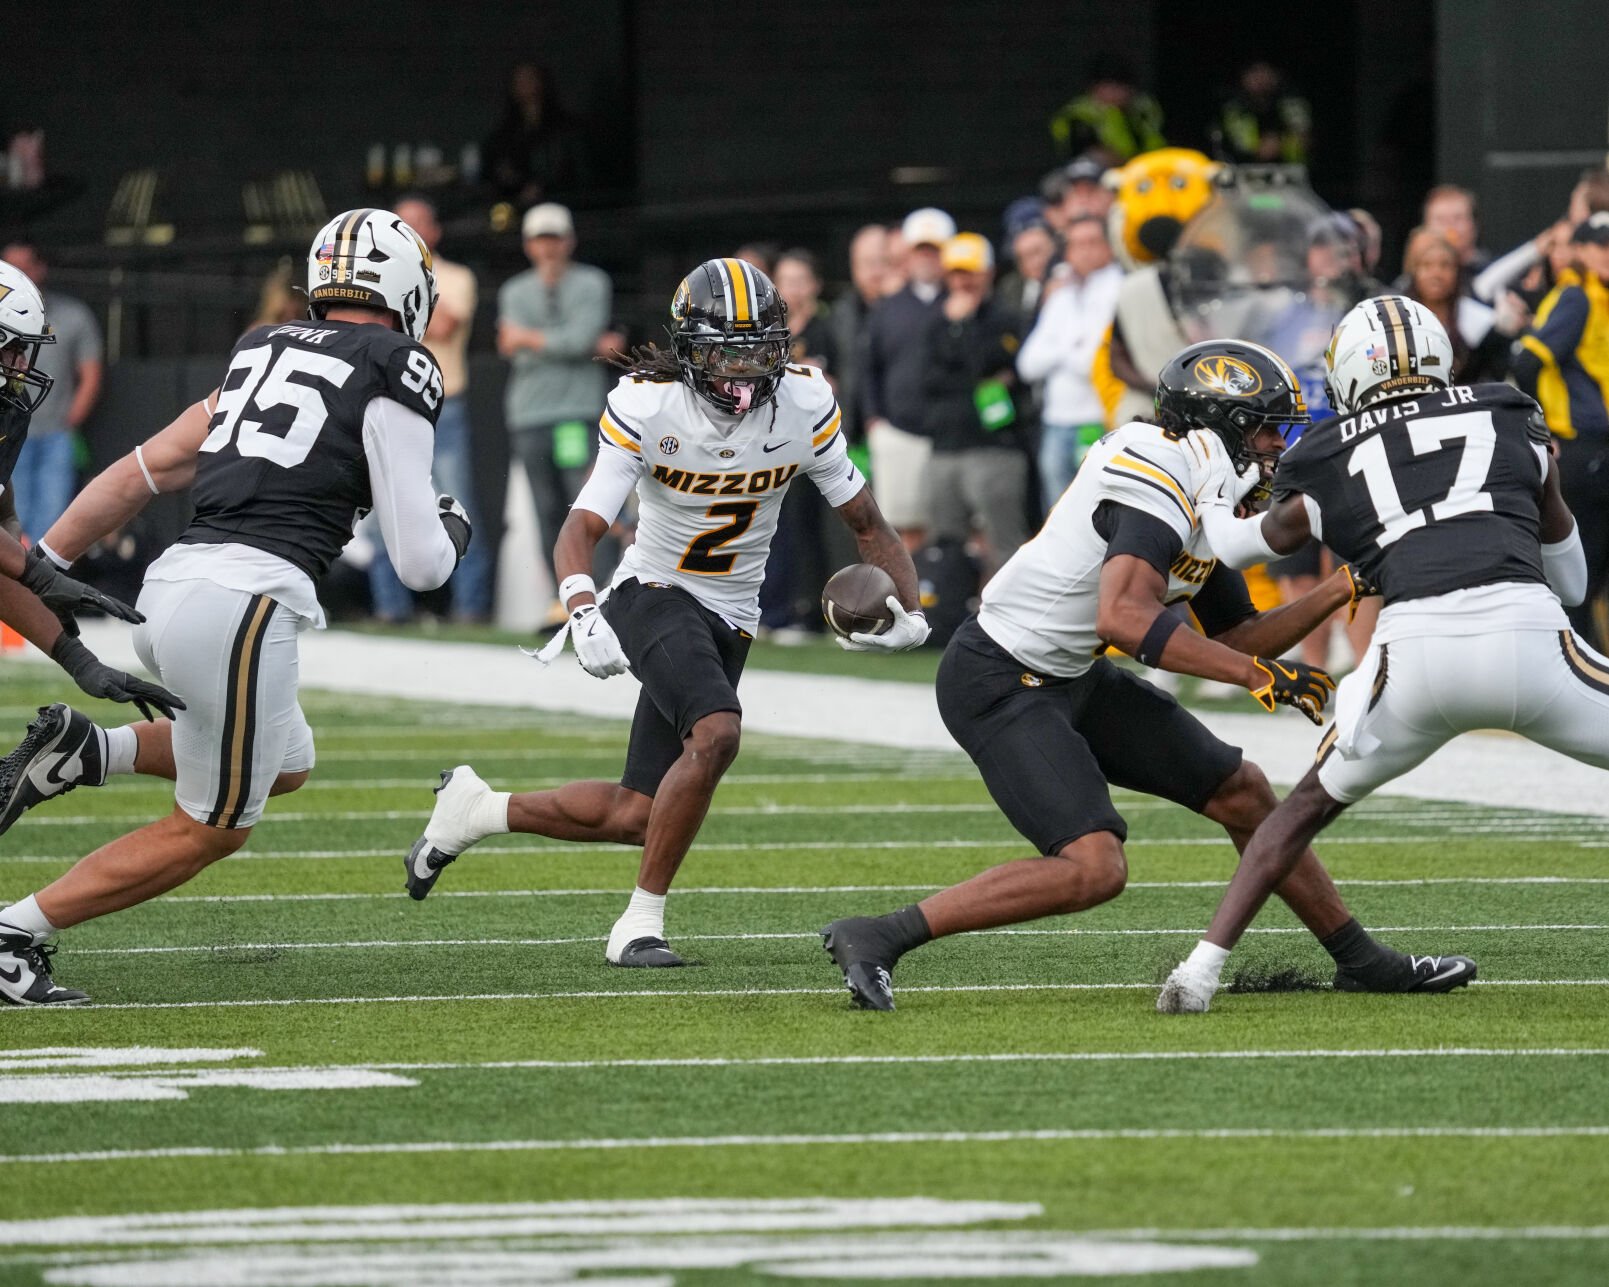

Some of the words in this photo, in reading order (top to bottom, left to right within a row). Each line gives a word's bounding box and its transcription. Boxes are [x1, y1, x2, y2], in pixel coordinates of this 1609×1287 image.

[313, 287, 371, 300] VANDERBILT
[198, 344, 355, 469] 95
[400, 350, 443, 410] 95
[1381, 375, 1430, 390] VANDERBILT
[1339, 401, 1420, 443] DAVIS
[1441, 386, 1478, 407] JR
[660, 436, 679, 455] SEC
[652, 463, 799, 496] MIZZOU
[1347, 411, 1497, 549] 17
[676, 499, 760, 575] 2
